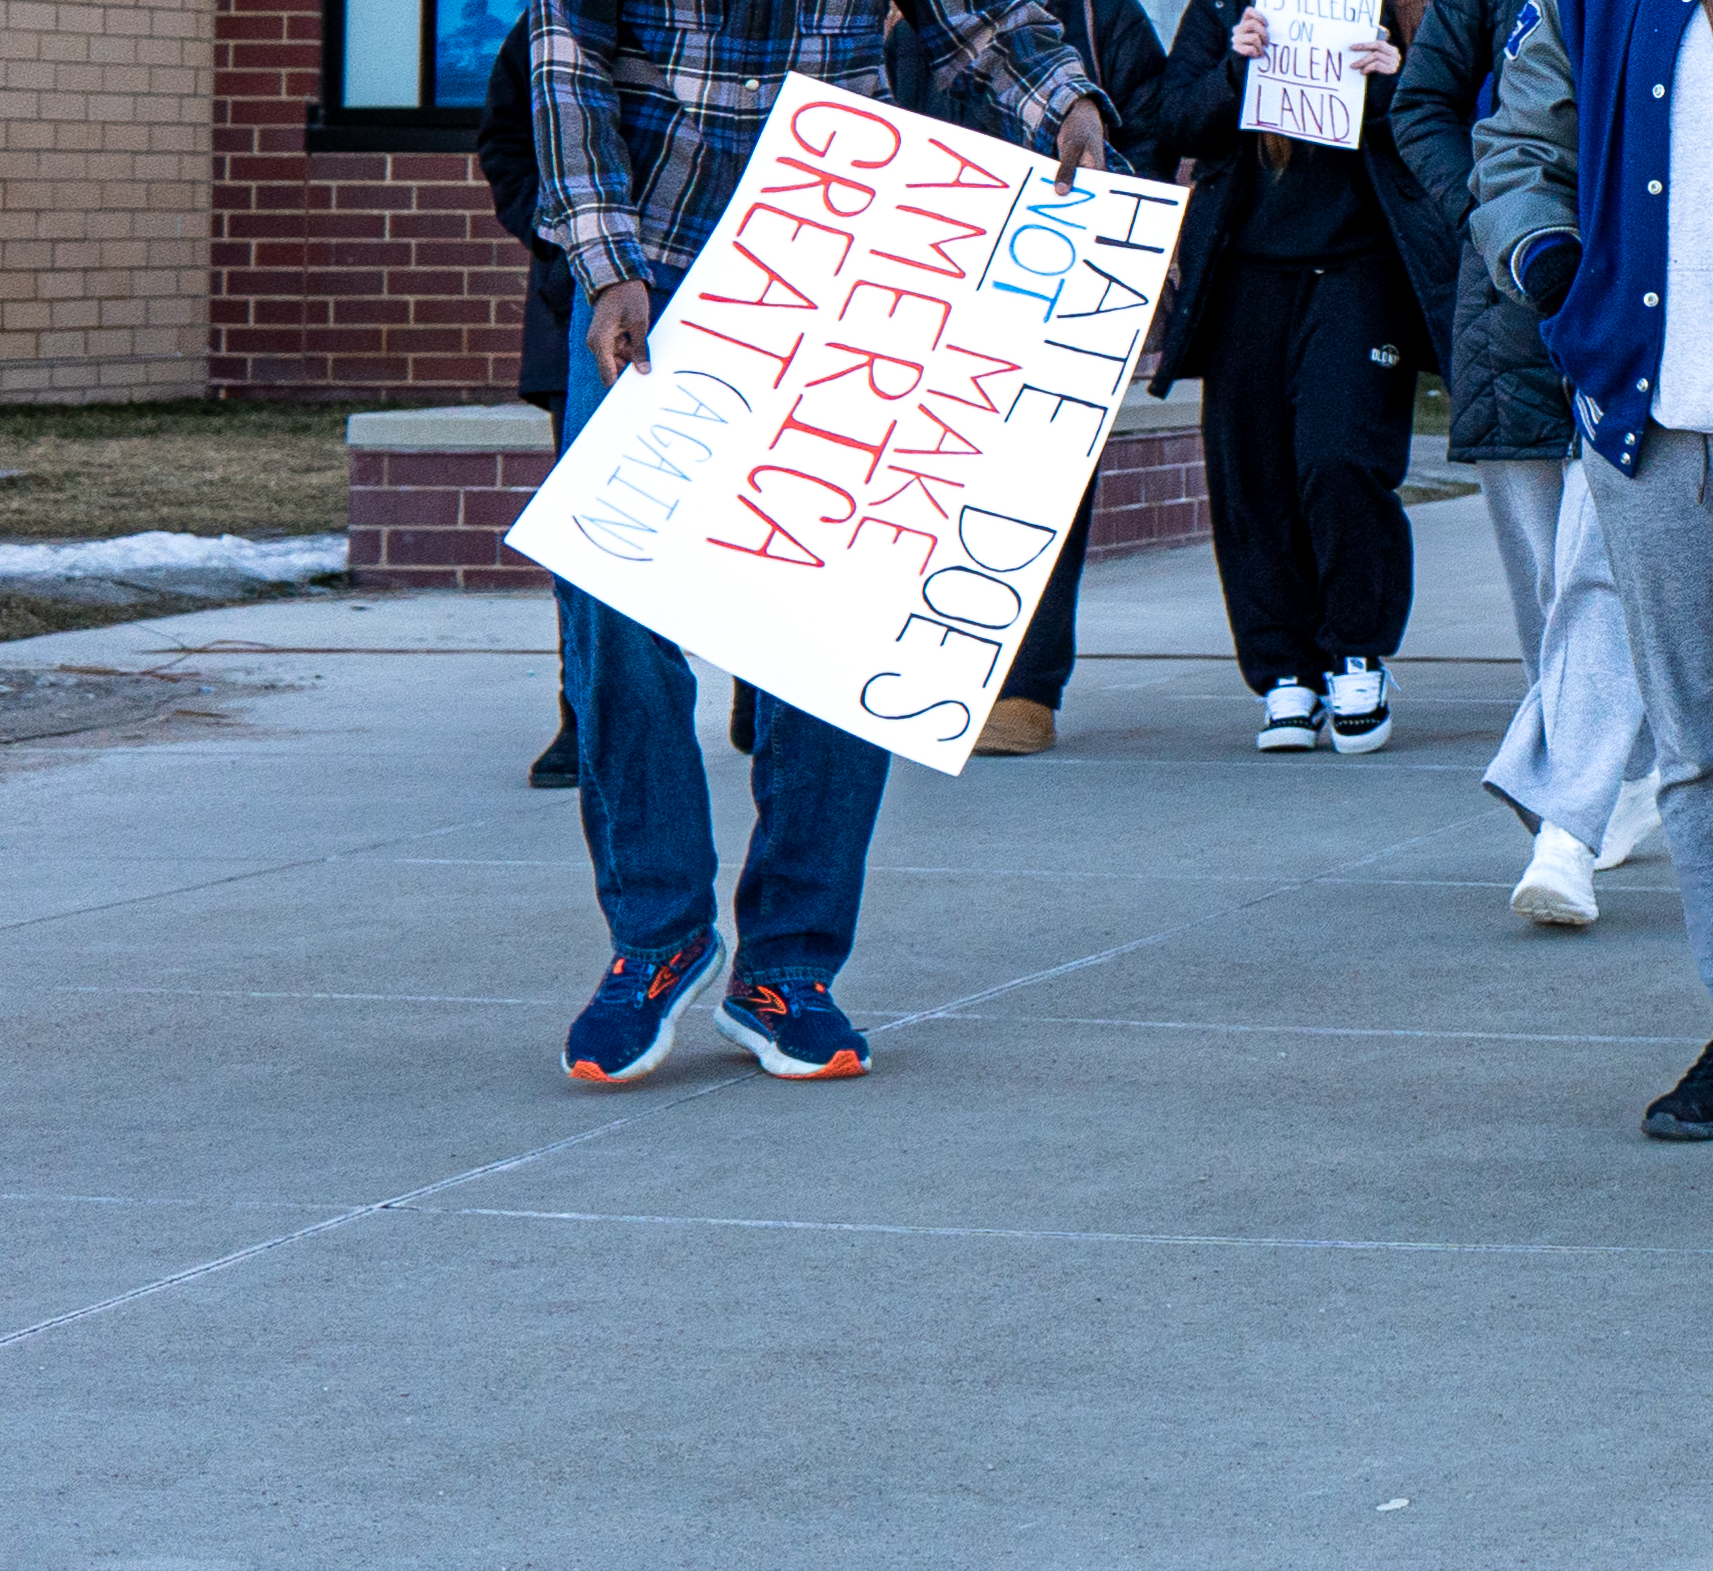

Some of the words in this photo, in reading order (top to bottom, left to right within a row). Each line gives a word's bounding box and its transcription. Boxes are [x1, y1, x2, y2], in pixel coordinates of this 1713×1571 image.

[1255, 83, 1350, 142] LAND
[1257, 42, 1342, 83] STOLEN
[1288, 19, 1314, 43] ON
[680, 100, 902, 390] GREAT
[992, 176, 1096, 324] NOT
[1005, 188, 1179, 458] HATE
[706, 137, 1010, 568] AMERICA
[571, 370, 753, 562] (AGAIN)
[846, 343, 1024, 576] MAKE
[859, 504, 1058, 743] DOES
